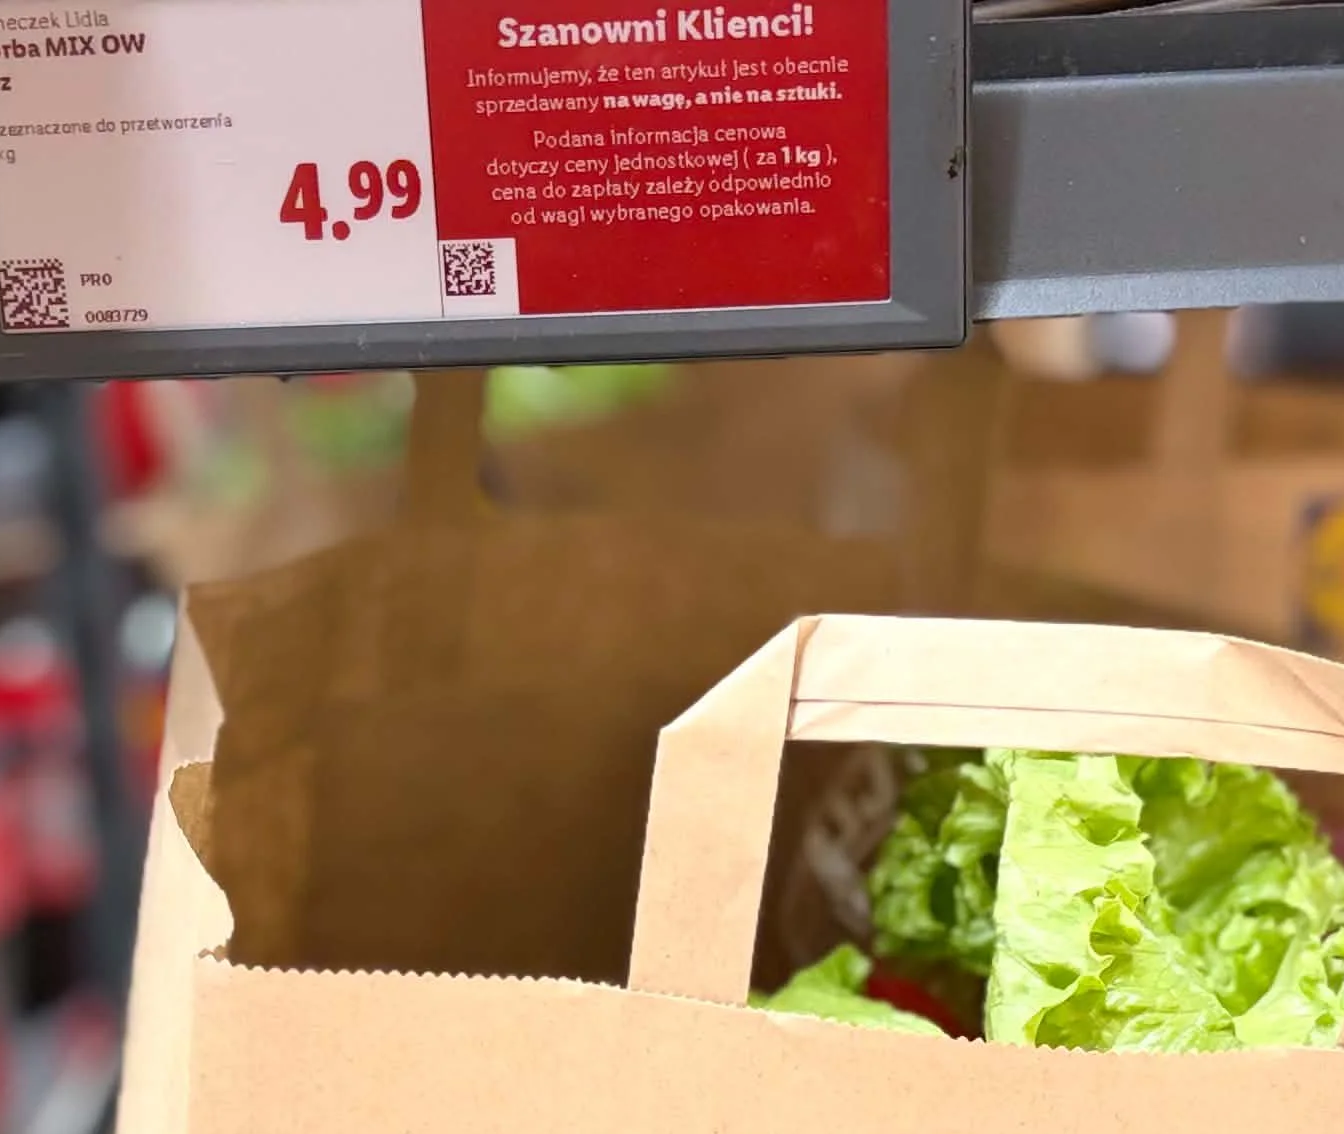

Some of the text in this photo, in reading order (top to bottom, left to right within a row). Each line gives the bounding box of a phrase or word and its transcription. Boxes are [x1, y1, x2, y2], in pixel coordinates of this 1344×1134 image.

[65, 10, 109, 28] Lidla
[498, 2, 814, 48] Szanowni Klienci!
[45, 35, 96, 57] MIX
[101, 33, 145, 54] OW
[466, 56, 849, 89] Informujemy, że ten artykuł jest obecnie
[476, 81, 843, 116] sprzedawany na wagę, a nie na sztuki.
[95, 118, 116, 133] do
[120, 113, 233, 136] przetworzenia
[533, 125, 787, 149] Podana informacja cenowa
[486, 158, 559, 178] dotyczy
[564, 158, 609, 177] ceny
[614, 149, 739, 175] jednostkowej
[756, 152, 777, 166] za
[280, 159, 422, 241] 4.99
[492, 171, 832, 201] cena do zapłaty zależy odpowiednio
[511, 198, 816, 227] od wagi wybranego opakowania.
[80, 273, 112, 286] PRO
[85, 309, 148, 323] 0083729
